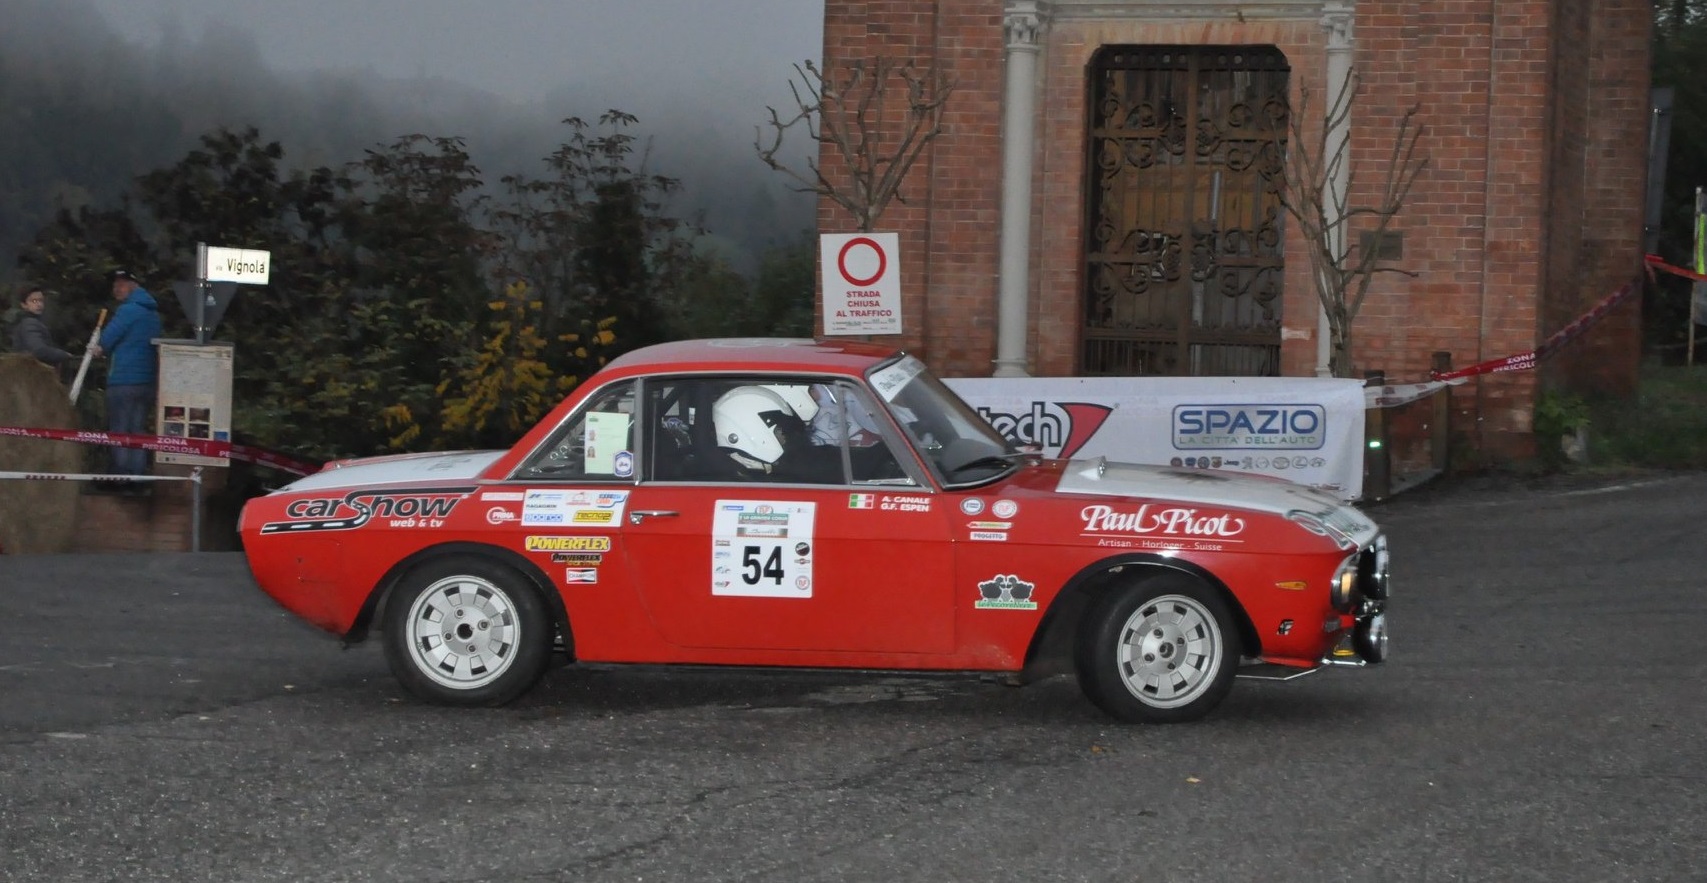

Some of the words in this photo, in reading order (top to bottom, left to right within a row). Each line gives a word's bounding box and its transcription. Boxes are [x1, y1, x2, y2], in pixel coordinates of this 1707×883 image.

[227, 258, 265, 275] Vignola
[846, 290, 881, 298] STRADA
[847, 300, 881, 308] CHIUSA
[850, 309, 892, 317] TRAFFICO
[1507, 353, 1535, 365] ZONA
[1179, 409, 1318, 435] SPAZIO
[77, 431, 109, 439] ZONA
[1179, 436, 1196, 445] LA
[157, 437, 188, 446] ZONA
[142, 442, 201, 455] PERICOLOSA
[894, 496, 931, 504] CANALE
[900, 504, 930, 512] ESPEN
[390, 517, 415, 528] web
[418, 518, 427, 528] &
[430, 518, 444, 528] tv
[1080, 504, 1160, 533] Paul
[1160, 508, 1245, 537] Picot
[525, 536, 609, 551] POWERFLEX
[1098, 539, 1132, 548] Artisan
[1194, 541, 1223, 551] Suisse
[742, 546, 785, 586] 54
